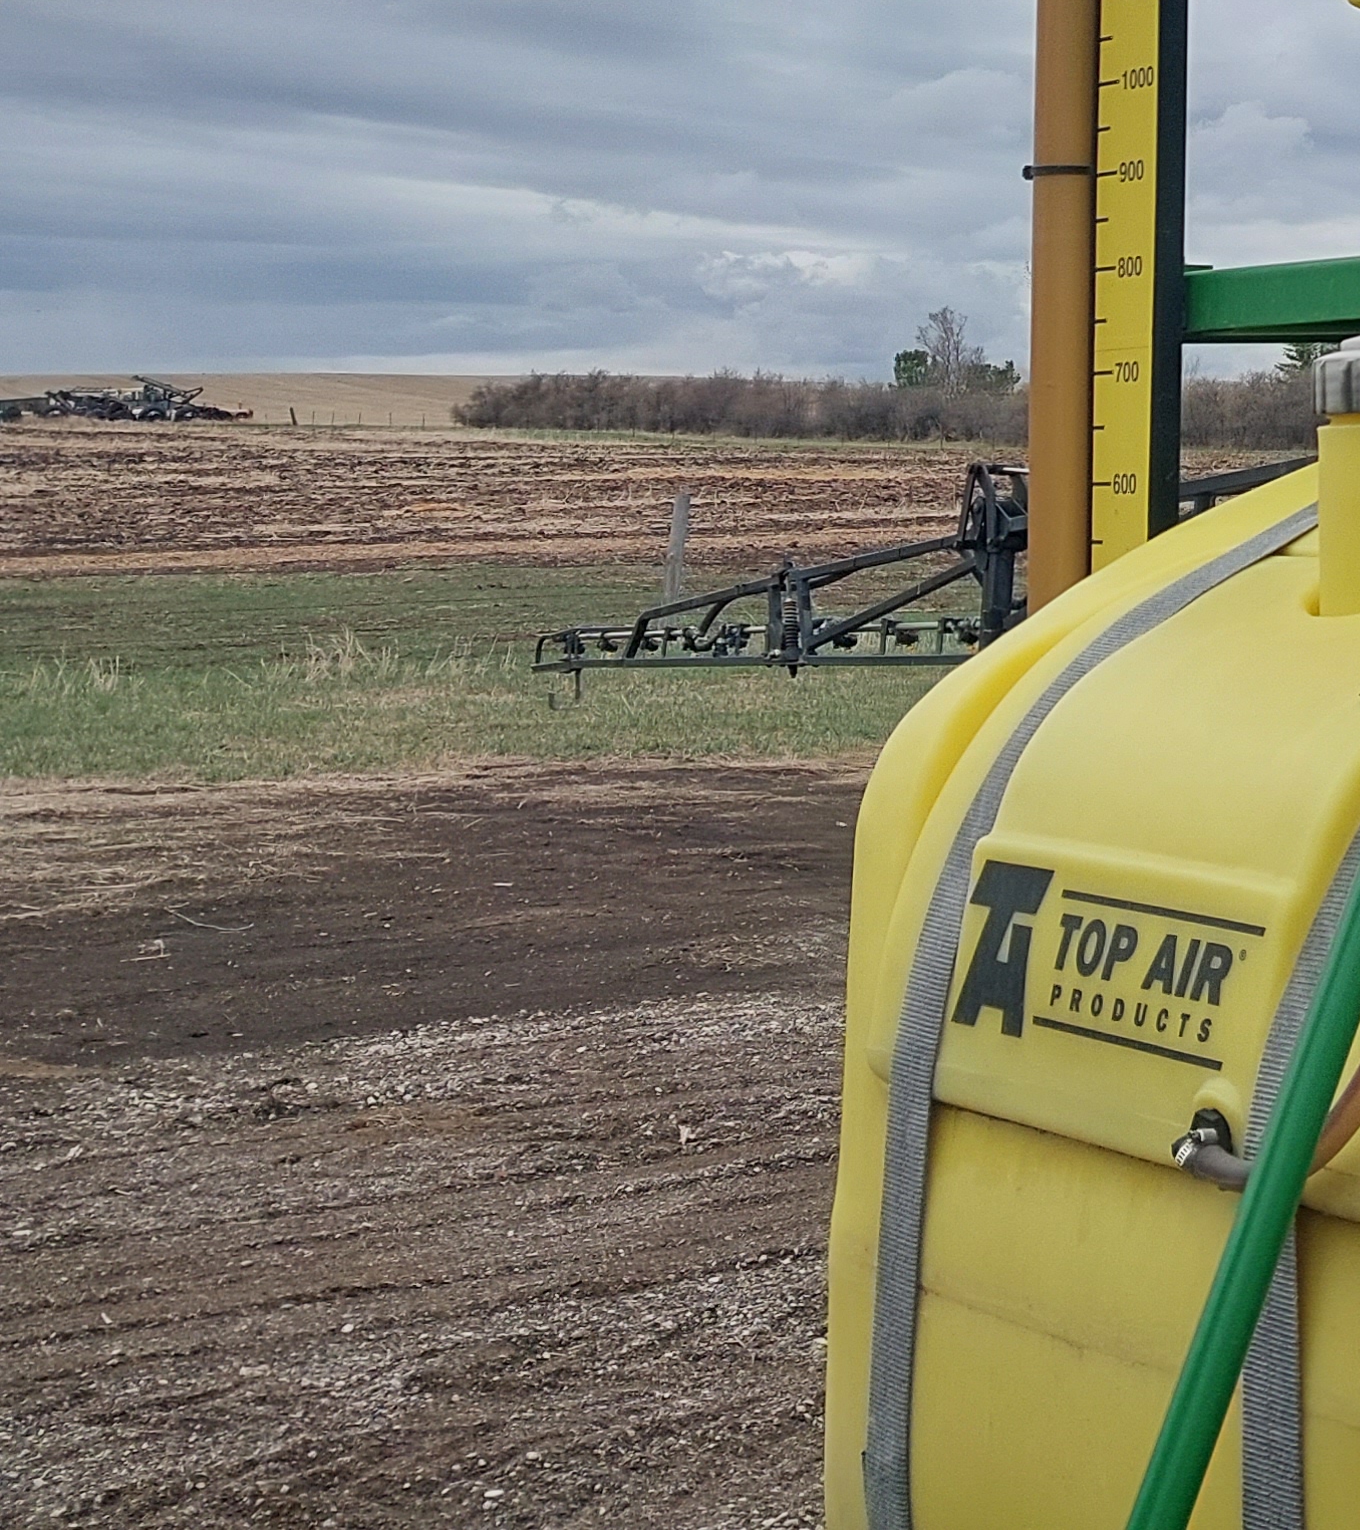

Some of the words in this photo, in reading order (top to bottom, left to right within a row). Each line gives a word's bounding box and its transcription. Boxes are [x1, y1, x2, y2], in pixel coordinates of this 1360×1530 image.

[1120, 66, 1154, 90] 1000
[1118, 159, 1144, 182] 900
[1117, 256, 1142, 278] 800
[1114, 361, 1139, 383] 700
[1112, 473, 1136, 495] 600
[1054, 913, 1138, 982] TOP
[1141, 934, 1233, 1006] AIR
[1050, 984, 1212, 1042] PRODUCTS
